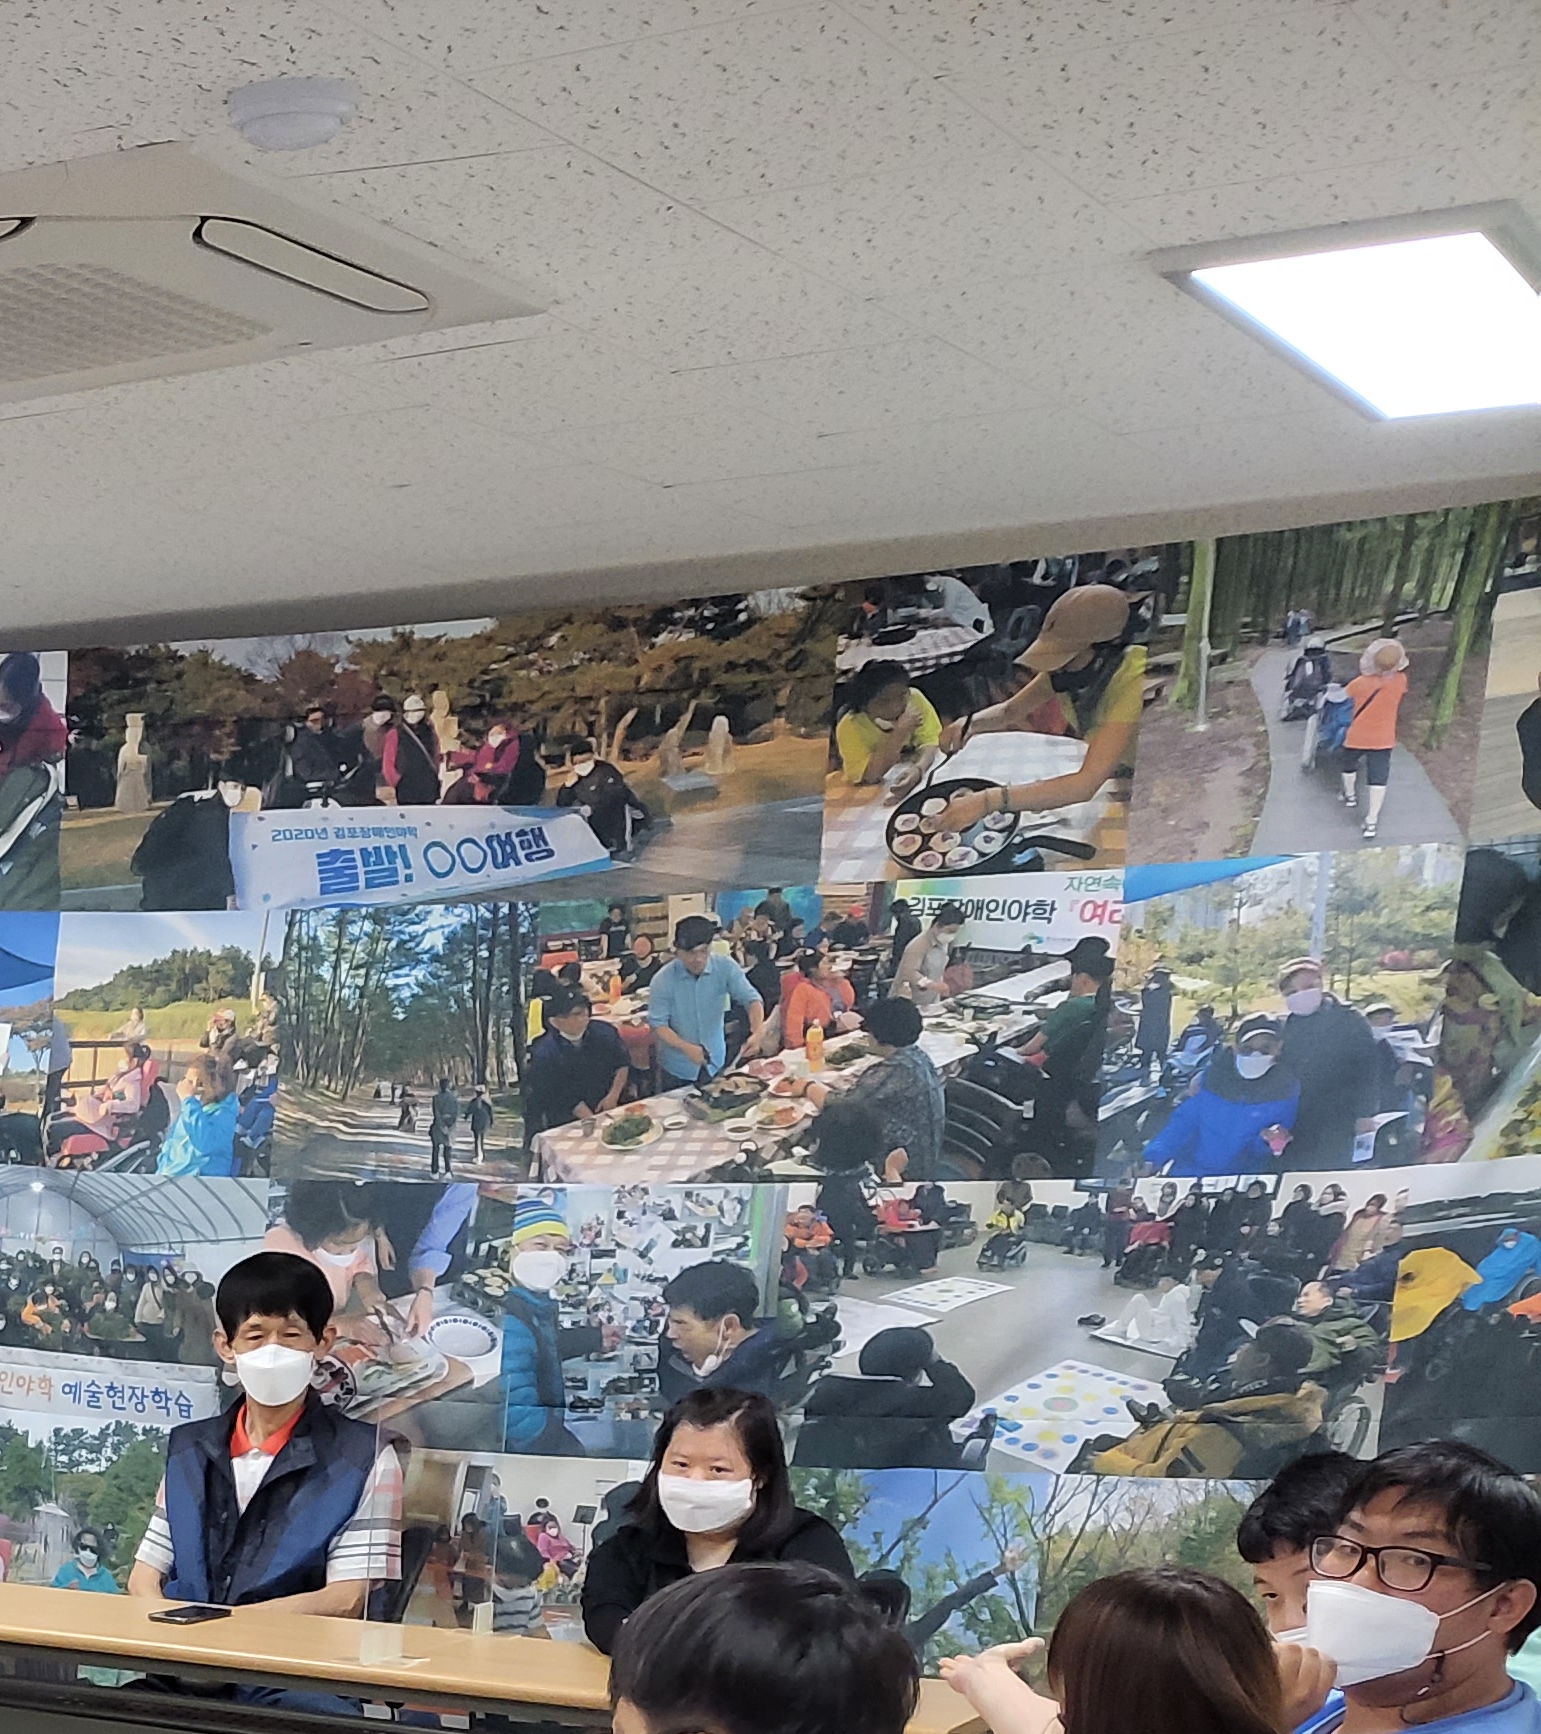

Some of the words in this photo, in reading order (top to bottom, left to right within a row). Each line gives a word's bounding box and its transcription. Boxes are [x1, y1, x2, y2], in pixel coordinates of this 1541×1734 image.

[271, 827, 328, 842] 2020년
[316, 844, 414, 895] 출발!
[61, 1379, 194, 1419] 예술현장학습
